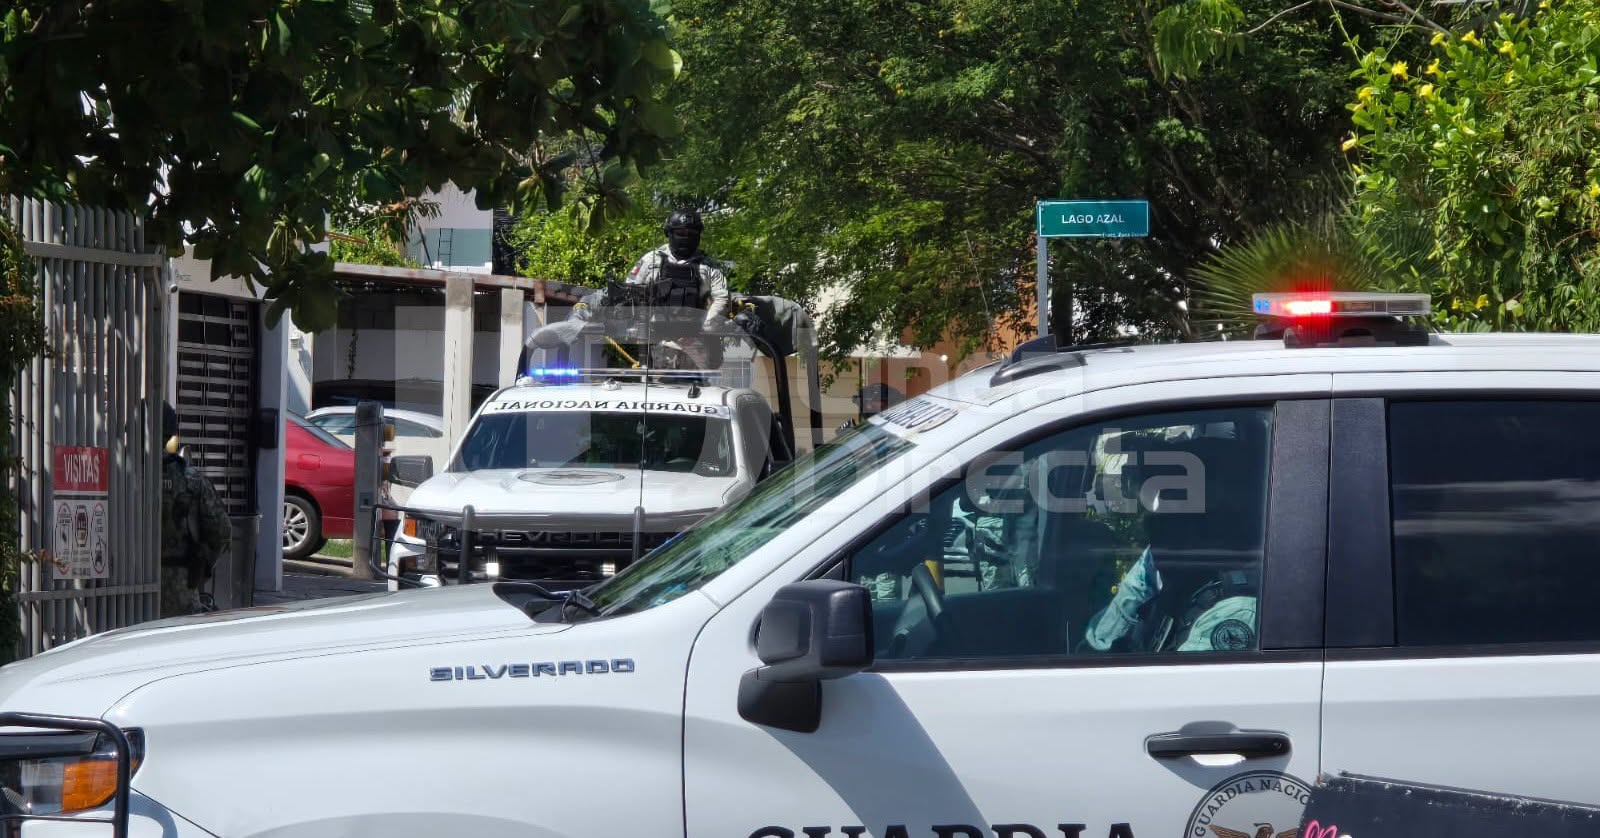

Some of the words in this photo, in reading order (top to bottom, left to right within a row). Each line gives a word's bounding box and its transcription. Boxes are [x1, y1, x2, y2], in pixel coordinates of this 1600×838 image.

[1061, 214, 1094, 224] LAGO
[1096, 214, 1125, 223] AZAL
[63, 453, 100, 483] VISITAS
[429, 658, 635, 682] SILVERADO
[1194, 780, 1255, 837] GUARDIA
[1261, 779, 1310, 805] NACIO
